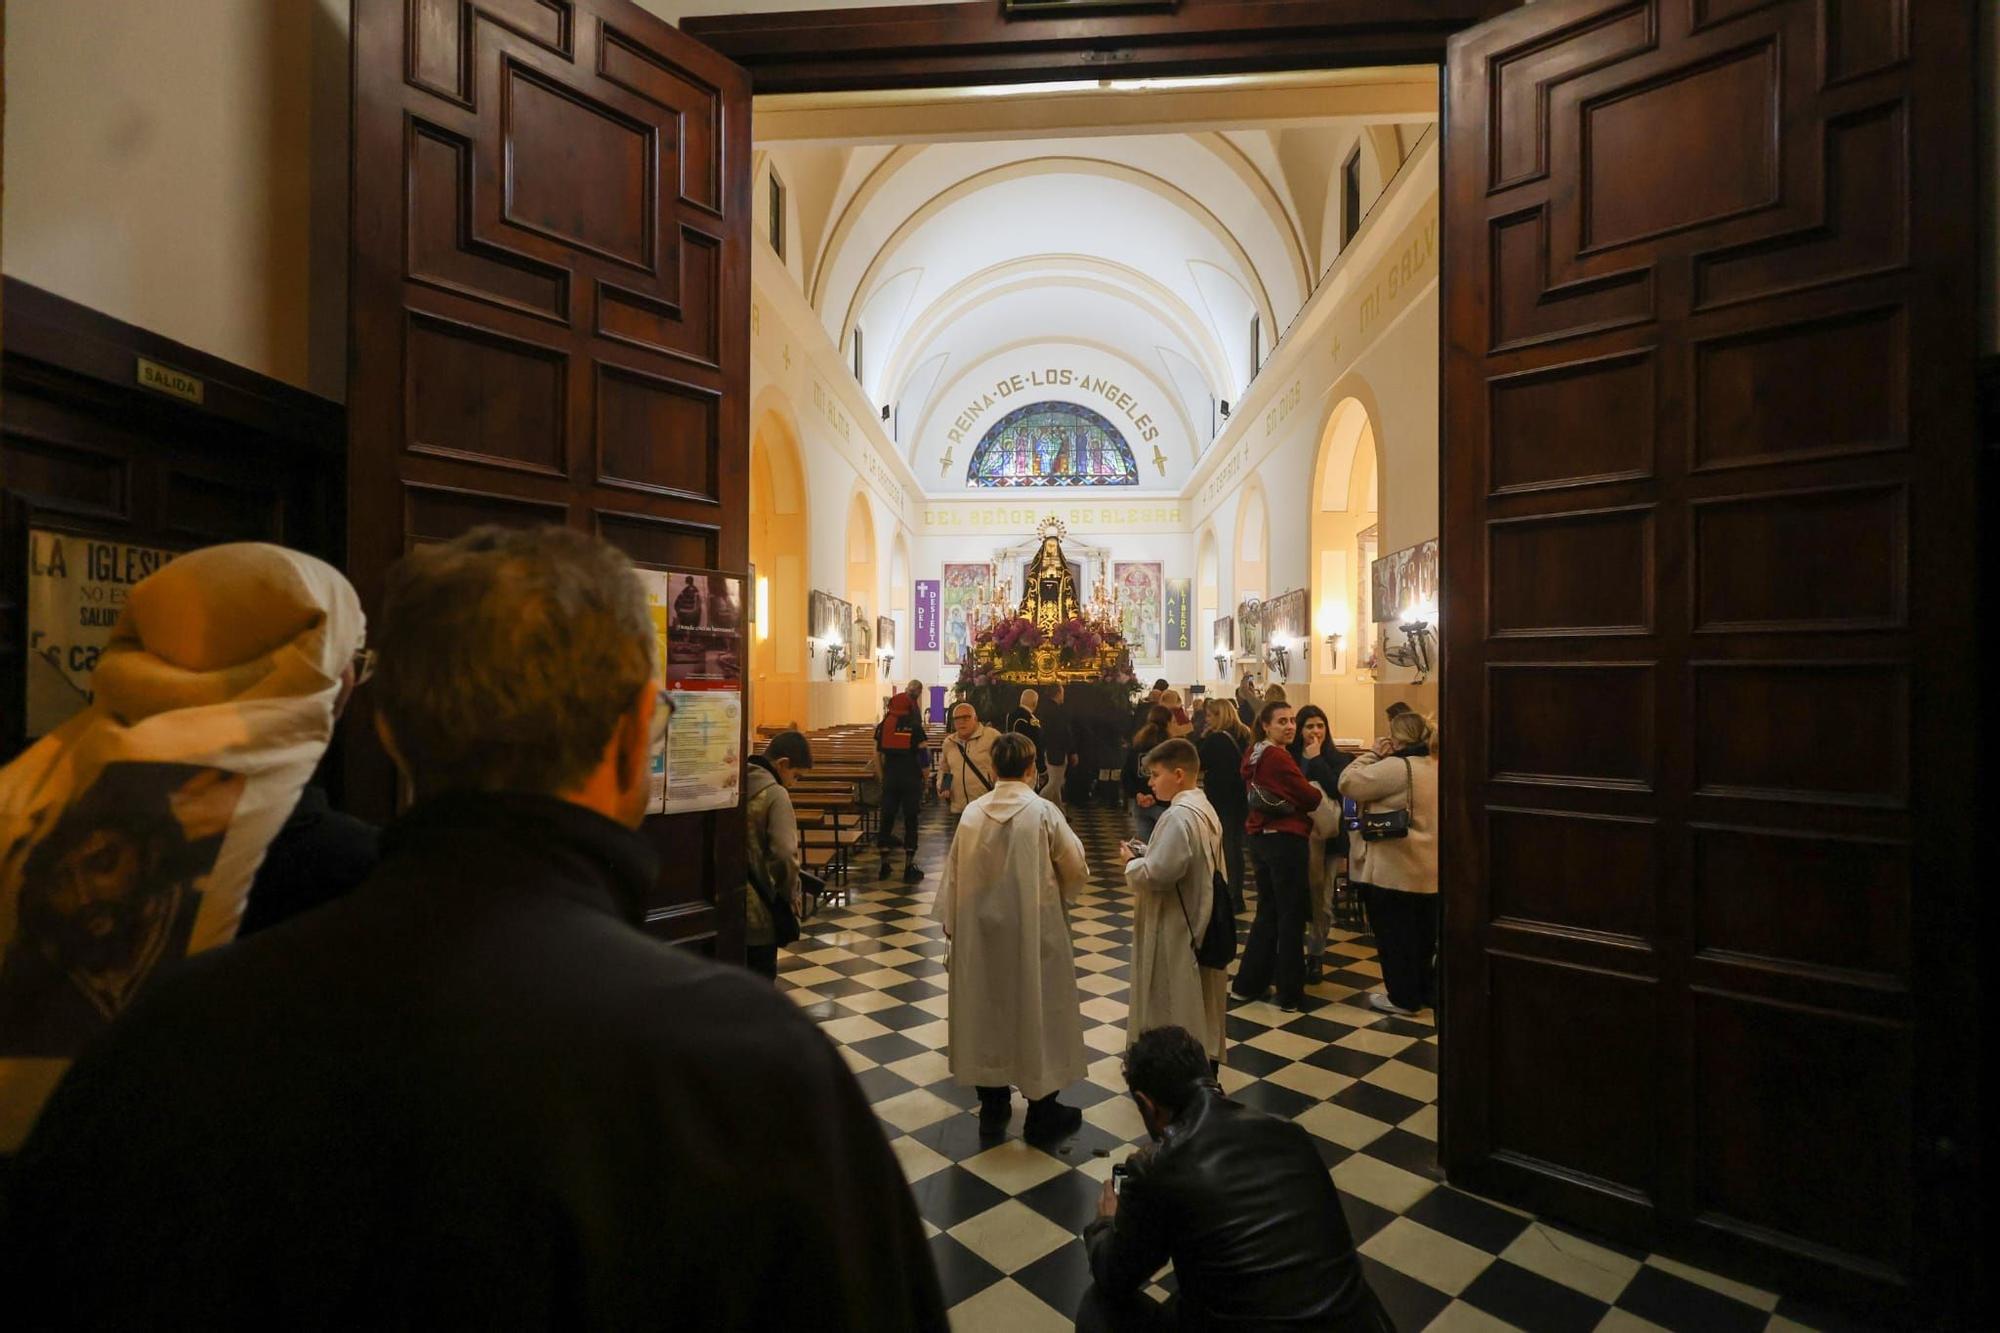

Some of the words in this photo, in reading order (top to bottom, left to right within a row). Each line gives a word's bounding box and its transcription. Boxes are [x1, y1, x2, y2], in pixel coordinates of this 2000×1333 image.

[1388, 218, 1436, 300] SALV
[143, 367, 197, 395] SALIDA
[948, 394, 995, 445] REINA
[997, 375, 1025, 398] DE
[1031, 368, 1073, 386] LOS
[1079, 373, 1160, 443] ANGELES
[33, 534, 68, 578] LA
[87, 542, 173, 584] IGLESI
[928, 591, 937, 649] DESIERTO
[1179, 588, 1187, 648] LIBERTAD
